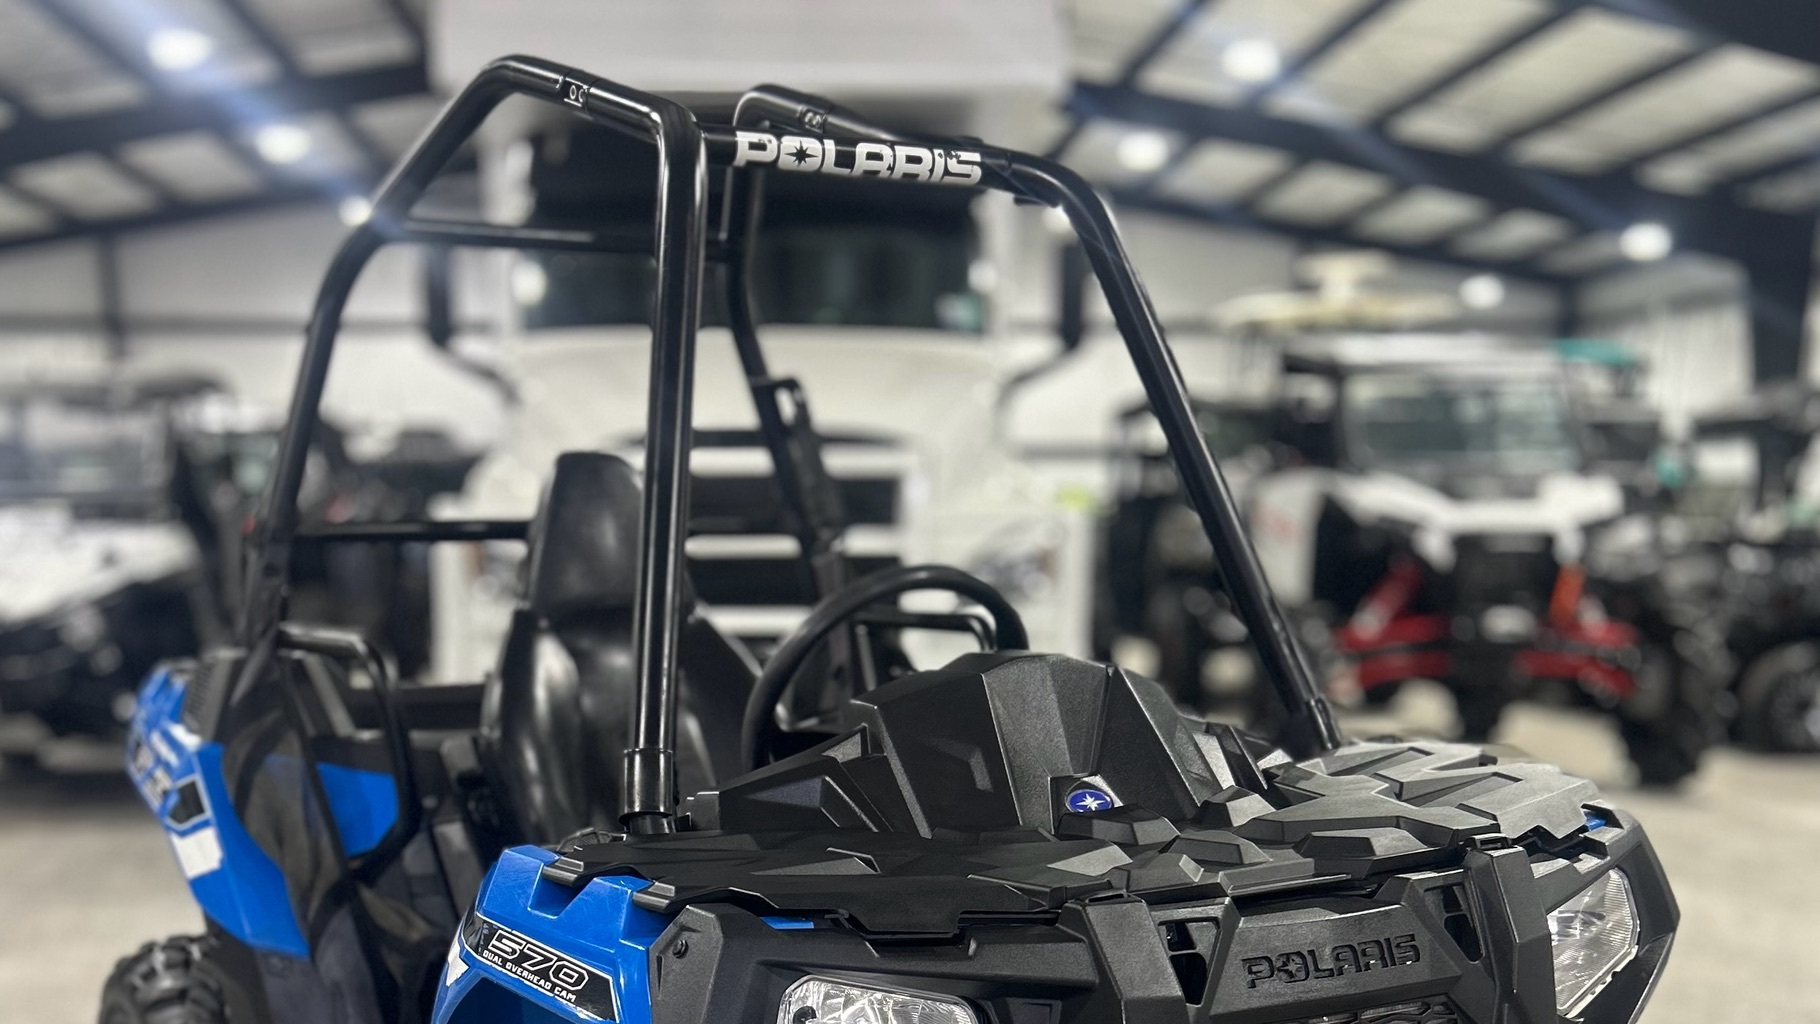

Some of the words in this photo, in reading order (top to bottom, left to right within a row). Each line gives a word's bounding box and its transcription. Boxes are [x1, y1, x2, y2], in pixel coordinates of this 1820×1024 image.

[733, 130, 982, 185] POLARIS
[483, 949, 503, 970] DUAL
[505, 962, 552, 991] OVERHEAD
[554, 986, 577, 1003] CAM
[488, 929, 589, 991] 570
[1241, 933, 1421, 989] POLARIS
